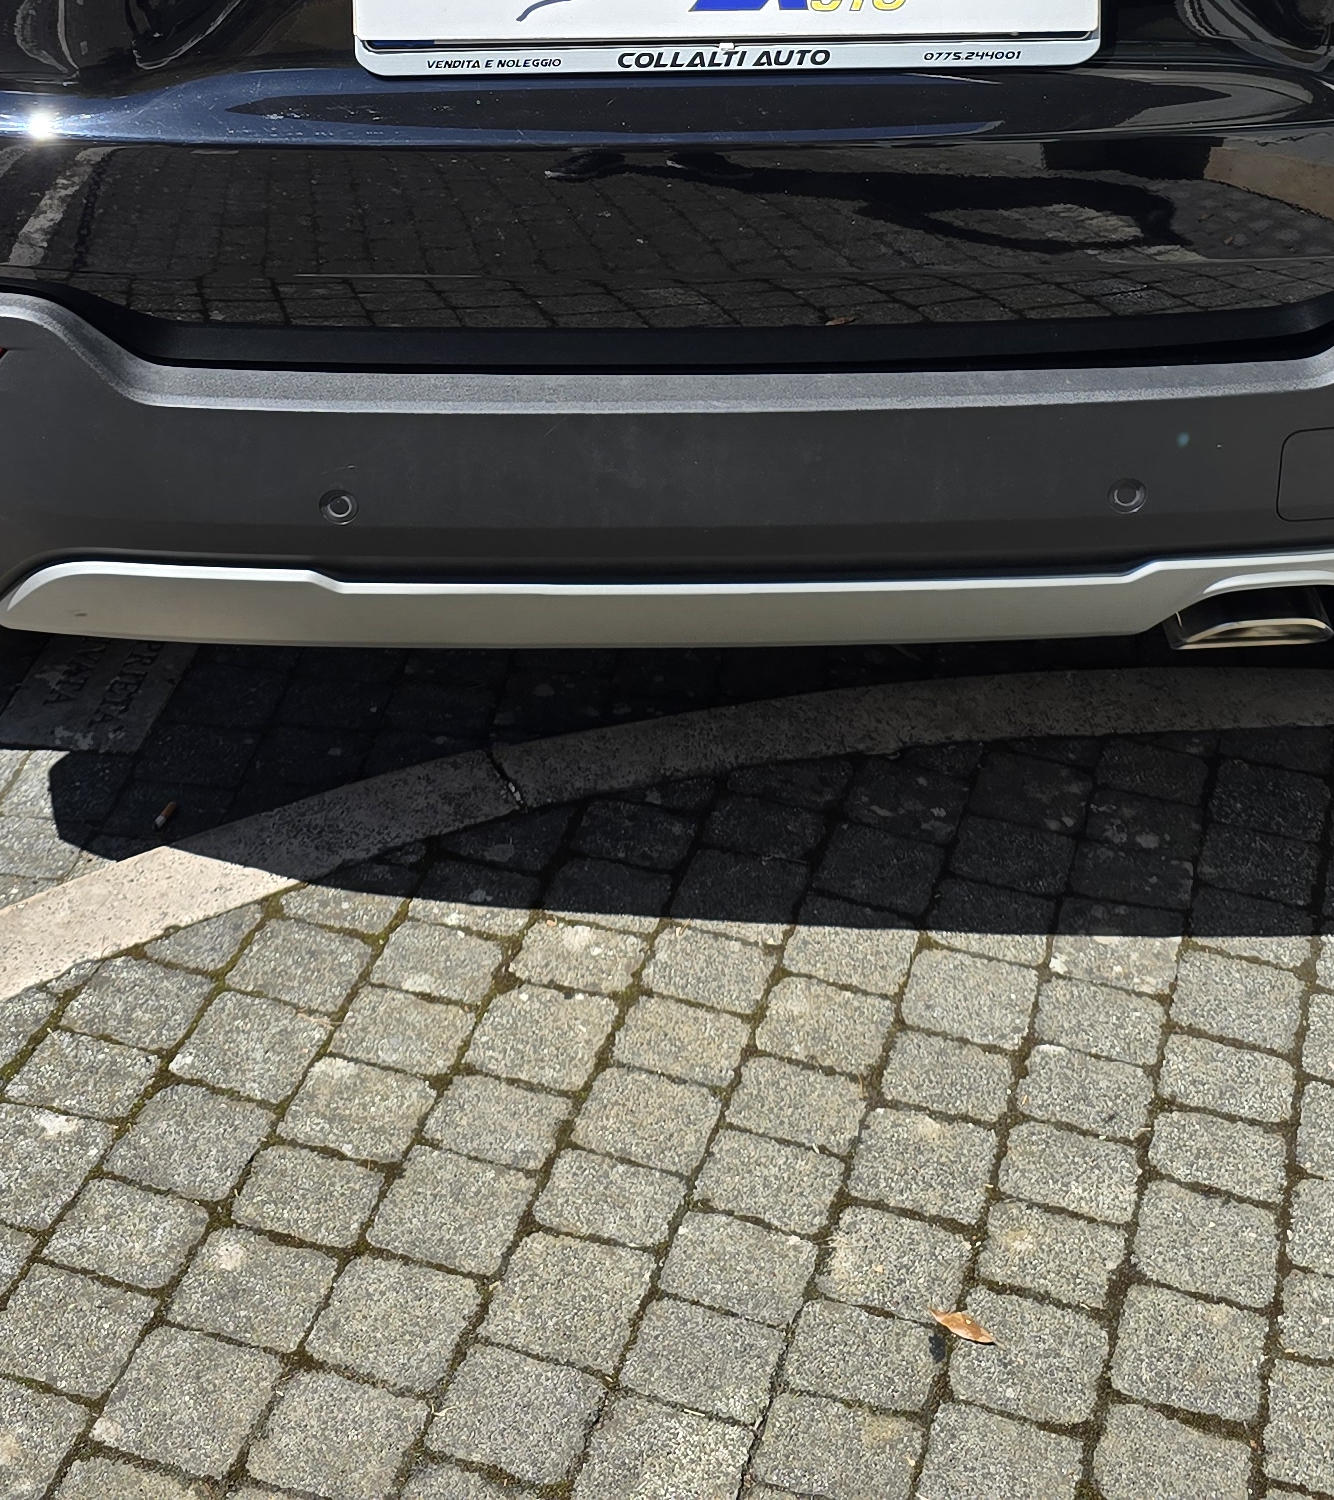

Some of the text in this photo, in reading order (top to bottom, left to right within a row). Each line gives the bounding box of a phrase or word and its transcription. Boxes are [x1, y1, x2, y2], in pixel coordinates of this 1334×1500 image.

[617, 49, 832, 69] COLLALTI AUTO
[923, 50, 1022, 62] 0775.244001
[426, 57, 562, 70] VENDITA E NOLEGGIO
